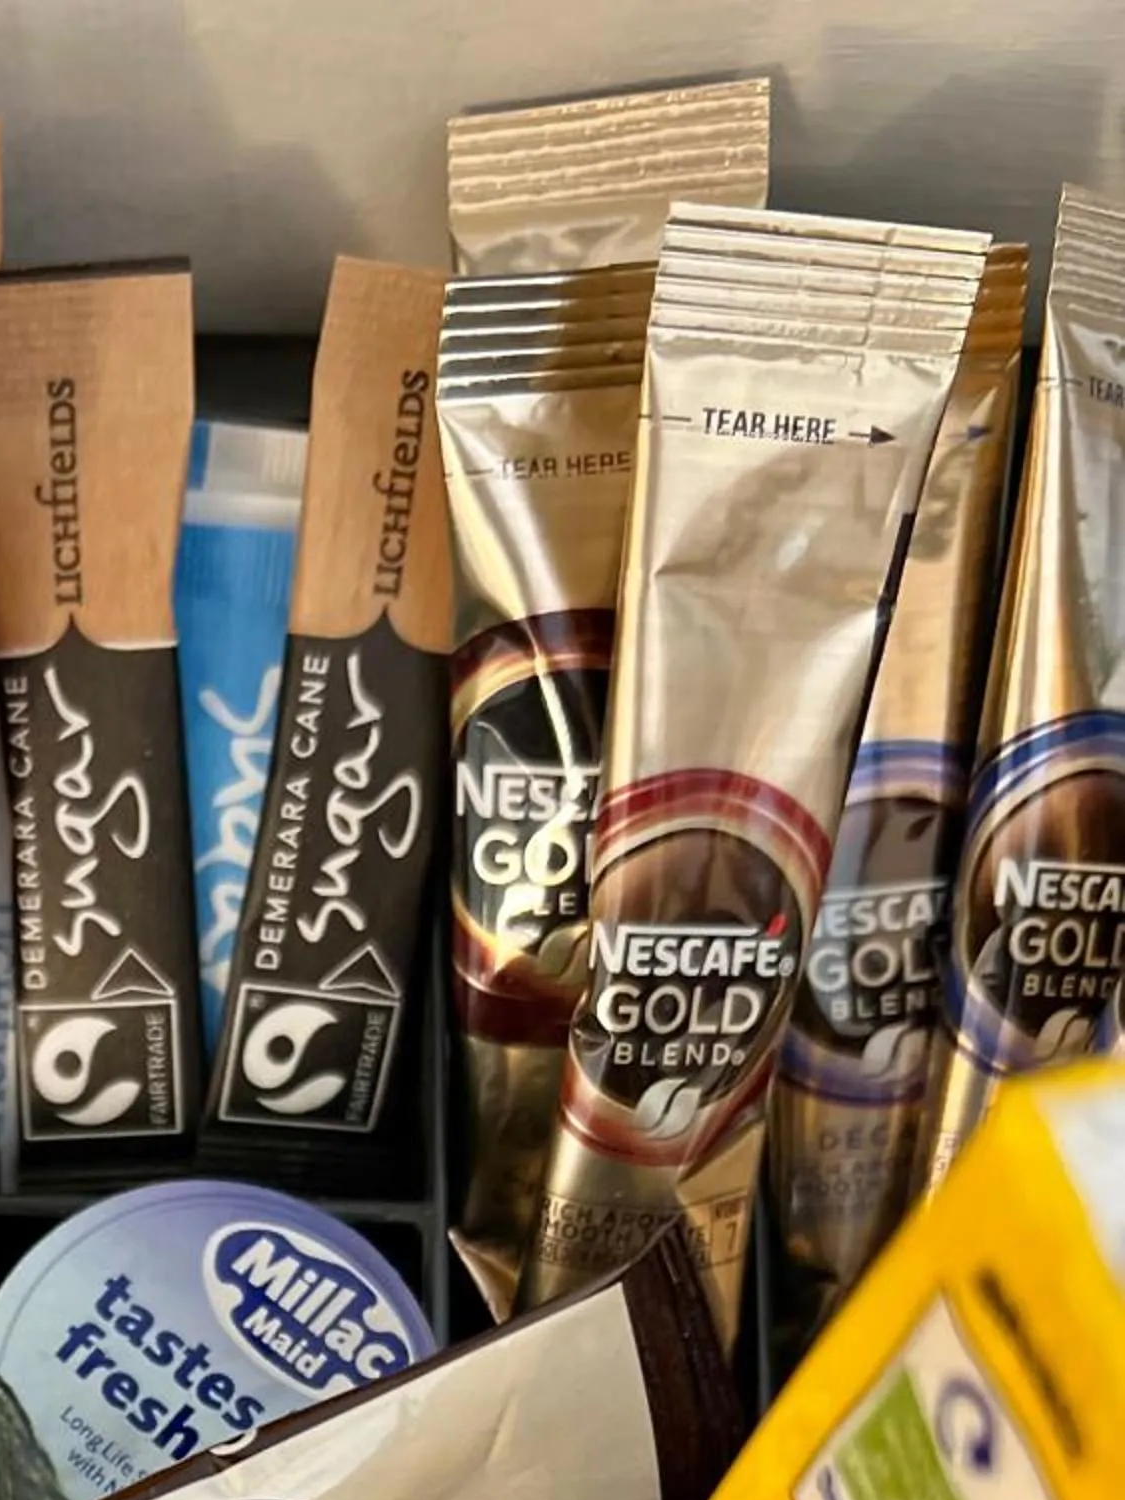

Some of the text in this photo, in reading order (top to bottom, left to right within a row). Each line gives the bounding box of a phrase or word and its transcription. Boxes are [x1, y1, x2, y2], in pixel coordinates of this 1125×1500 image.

[498, 452, 631, 480] TEAR HERE
[702, 408, 837, 444] TEAR HERE
[5, 675, 48, 990] DEMERARA CANE
[44, 666, 150, 957] sugar
[255, 653, 331, 971] DEMERARA CANE
[295, 653, 421, 943] sugar
[994, 858, 1125, 912] NESCA
[596, 984, 761, 1034] GOLD
[806, 938, 935, 994] GOL
[144, 1011, 167, 1128] FAIRTRADE
[344, 1009, 386, 1123] FAIRTRADE
[613, 1041, 732, 1067] BLEND
[93, 1273, 266, 1431] tastes
[230, 1236, 396, 1380] Millac
[242, 1306, 327, 1380] Maid
[54, 1320, 206, 1461] fresh
[59, 1404, 135, 1481] Long Life
[66, 1449, 106, 1487] with
